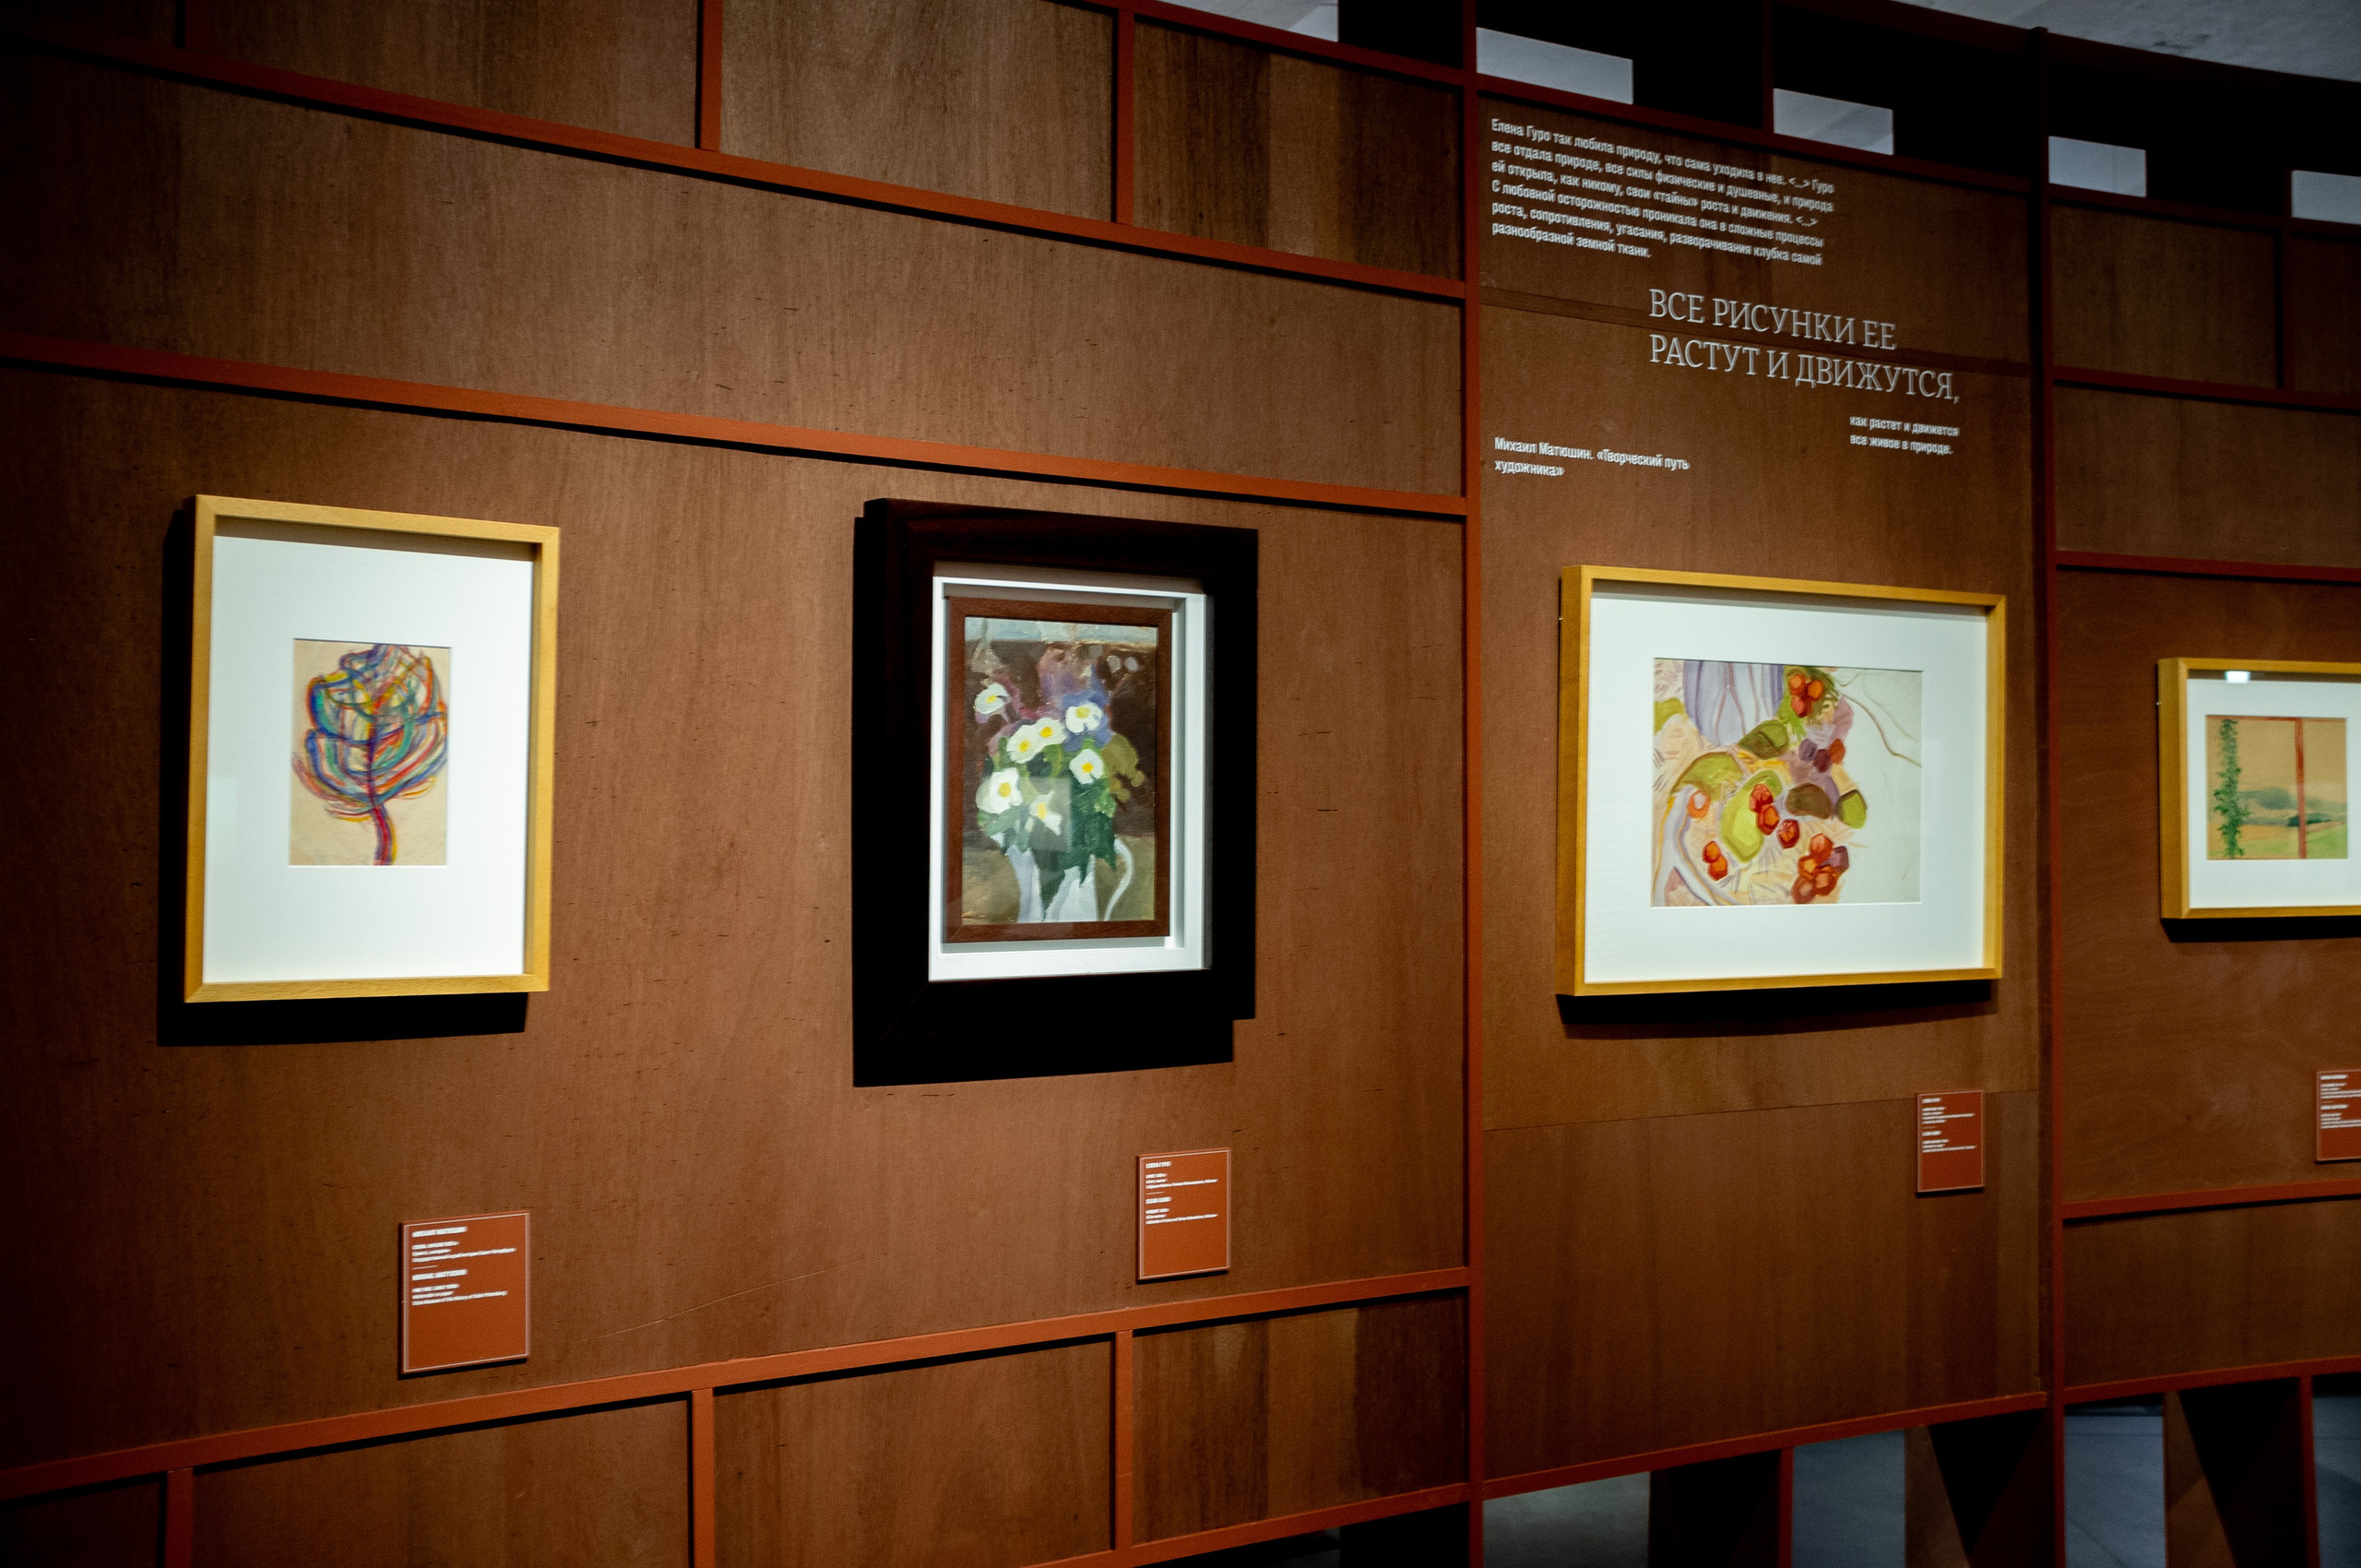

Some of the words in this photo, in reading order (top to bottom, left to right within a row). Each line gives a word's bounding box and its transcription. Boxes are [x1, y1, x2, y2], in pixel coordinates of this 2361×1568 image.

[1491, 118, 1524, 137] Елена
[1526, 125, 1551, 142] Гуро
[1553, 133, 1572, 146] так
[1573, 137, 1614, 154] любила
[1616, 146, 1662, 164] природу,
[1665, 154, 1683, 167] что
[1684, 158, 1712, 172] сама
[1713, 164, 1755, 180] уходила
[1757, 172, 1764, 182] в
[1765, 173, 1787, 185] нее.
[1811, 179, 1835, 195] Гуро
[1491, 141, 1513, 154] все
[1513, 145, 1553, 162] отдала
[1555, 153, 1604, 173] природе,
[1605, 162, 1624, 175] все
[1626, 166, 1654, 180] силы
[1655, 169, 1716, 191] физические
[1717, 184, 1725, 194] и
[1726, 184, 1781, 205] душевные,
[1784, 196, 1791, 205] и
[1792, 196, 1834, 213] природа
[1491, 160, 1506, 172] ей
[1507, 164, 1558, 184] открыла,
[1560, 174, 1581, 186] как
[1582, 178, 1624, 196] никому,
[1626, 185, 1651, 199] свои
[1653, 190, 1698, 207] «тайны»
[1701, 199, 1730, 214] роста
[1731, 204, 1738, 214] и
[1740, 206, 1794, 224] движения.
[1491, 179, 1501, 192] С
[1501, 184, 1556, 203] любовной
[1558, 194, 1642, 218] осторожностью
[1643, 208, 1697, 227] проникала
[1699, 219, 1718, 231] она
[1719, 221, 1727, 232] в
[1728, 222, 1774, 239] сложные
[1775, 231, 1824, 248] процессы
[1491, 202, 1528, 220] роста,
[1529, 208, 1614, 234] сопротивления,
[1616, 223, 1668, 244] угасания,
[1669, 232, 1752, 255] разворачивания
[1753, 245, 1789, 261] клубка
[1791, 254, 1823, 266] самой
[1491, 222, 1574, 243] разнообразной
[1575, 236, 1616, 253] земной
[1617, 243, 1652, 258] ткани.
[1649, 289, 1705, 324] ВСЕ
[1713, 298, 1856, 345] РИСУНКИ
[1862, 320, 1897, 350] ЕЕ
[1649, 334, 1761, 375] РАСТУТ
[1766, 350, 1790, 379] И
[1795, 354, 1960, 404] ДВИЖУТСЯ,
[1494, 436, 1537, 454] Михаил
[1538, 442, 1595, 460] Матюшин.
[1596, 449, 1663, 468] «Творческий
[1665, 457, 1691, 471] путь
[1850, 416, 1868, 428] как
[1869, 418, 1902, 432] растет
[1904, 422, 1910, 433] и
[1912, 423, 1960, 437] движется
[1850, 435, 1868, 446] все
[1869, 437, 1901, 450] живое
[1902, 441, 1909, 450] в
[1910, 441, 1953, 456] природе.
[1494, 459, 1565, 477] художника»
